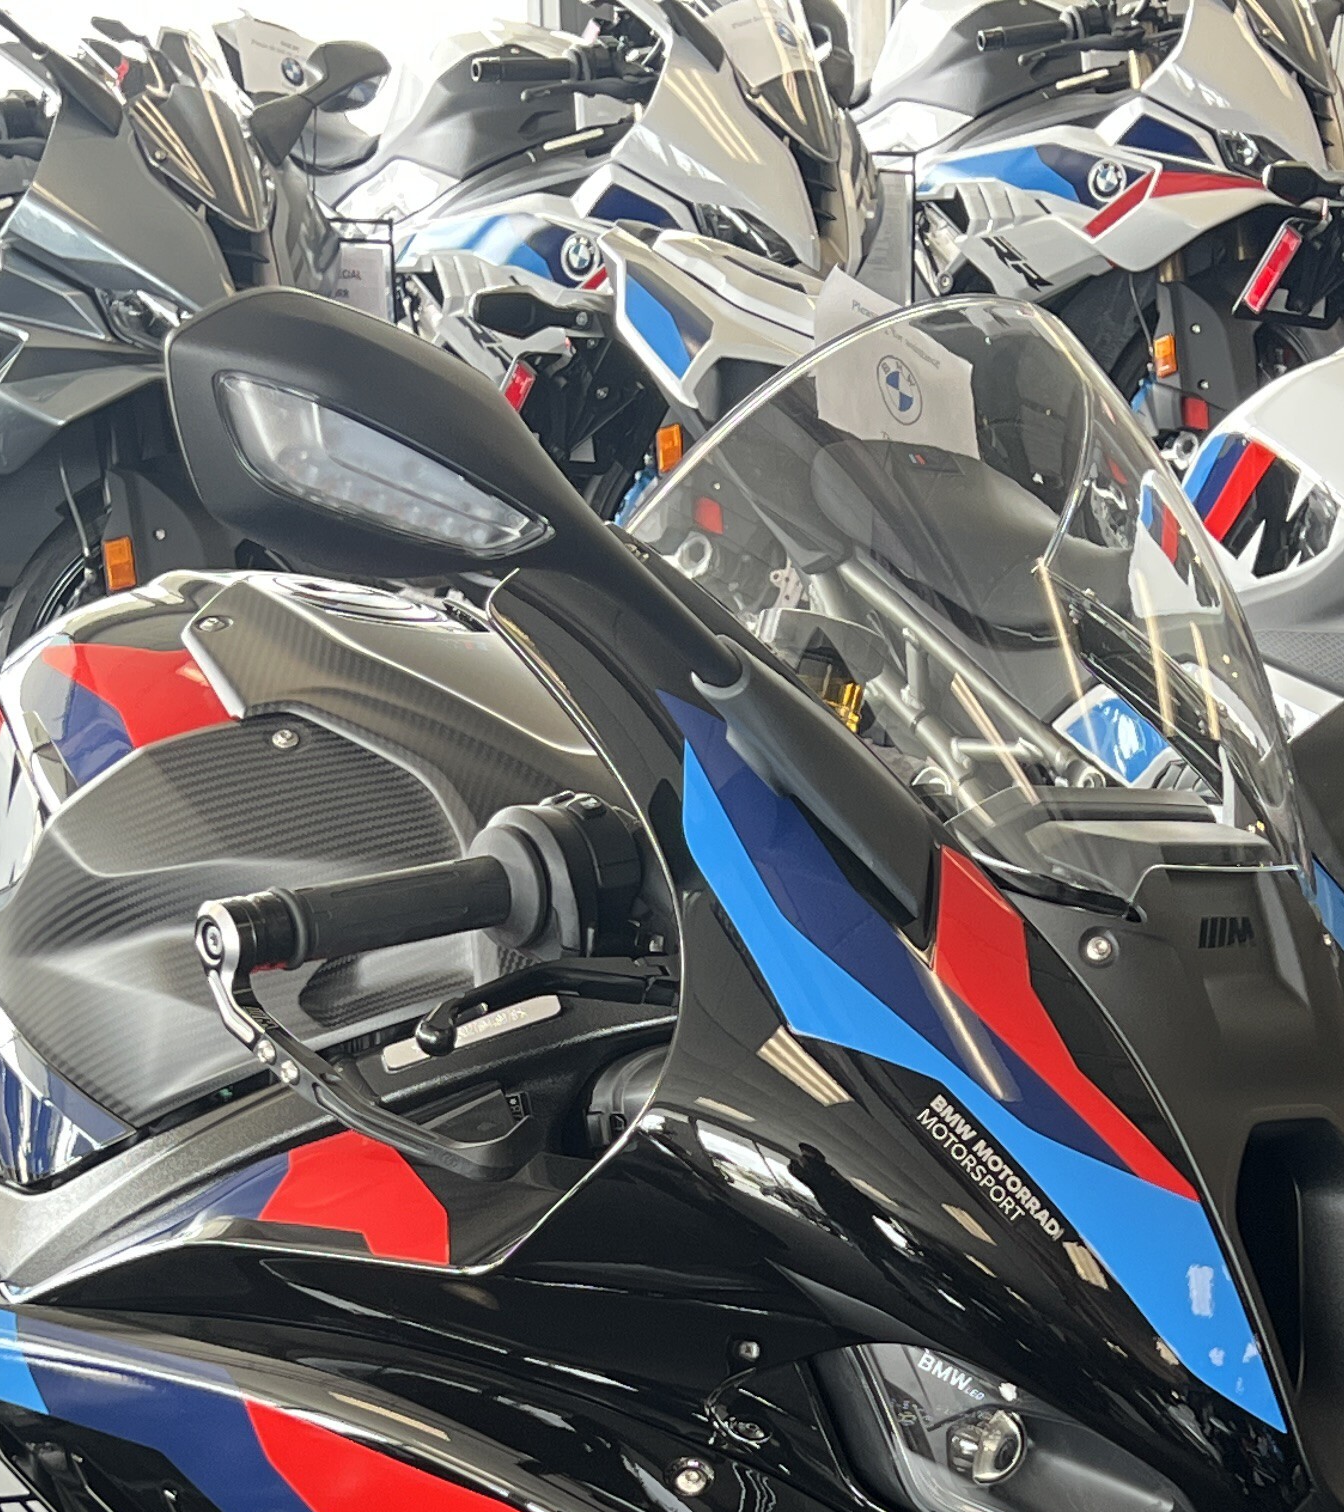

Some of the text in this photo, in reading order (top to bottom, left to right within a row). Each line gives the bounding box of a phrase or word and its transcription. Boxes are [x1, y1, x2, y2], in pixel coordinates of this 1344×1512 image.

[930, 1094, 977, 1141] BMW
[917, 1108, 1025, 1221] MOTORSPORT
[918, 1352, 972, 1391] BMW
